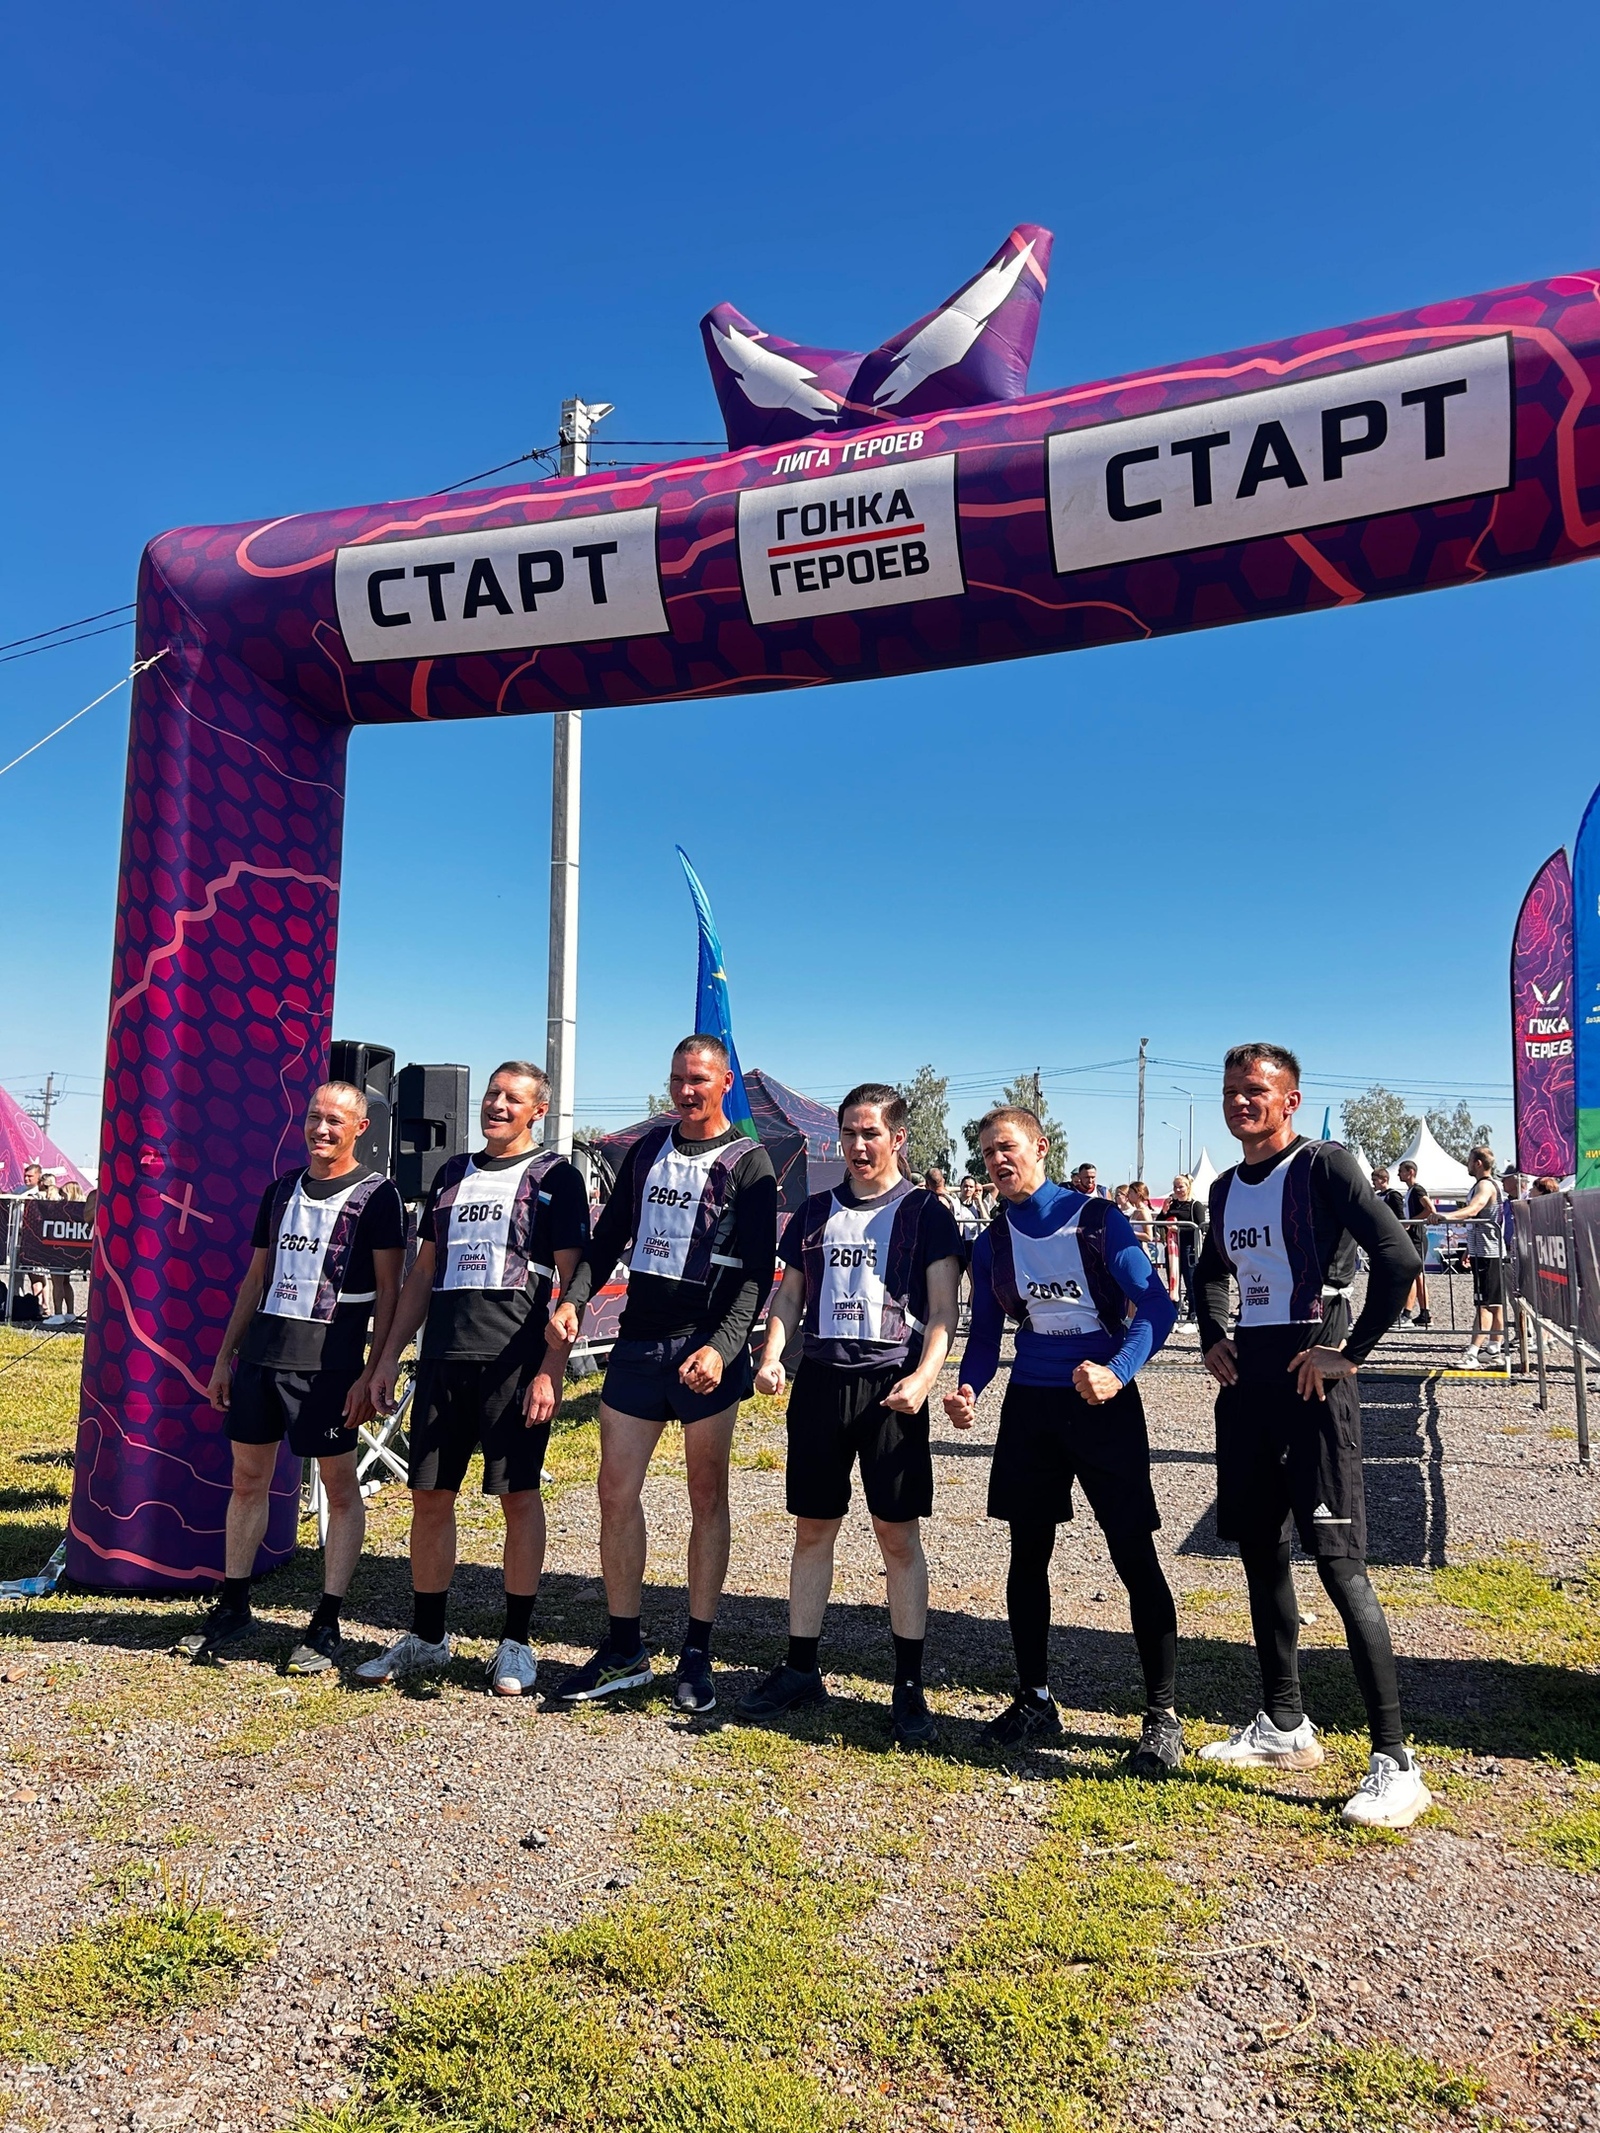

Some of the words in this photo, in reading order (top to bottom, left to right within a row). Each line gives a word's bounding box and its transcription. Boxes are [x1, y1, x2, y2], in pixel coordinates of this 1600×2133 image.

[772, 449, 830, 475] ЛИГА
[841, 430, 924, 463] ГЕРОЕВ
[1105, 378, 1467, 522] СТАРТ
[777, 488, 915, 540] ГОНКА
[769, 541, 930, 596] ГЕРОЕВ
[367, 541, 618, 628] СТАРТ
[647, 1185, 692, 1209] 260-2
[458, 1204, 503, 1223] 260-6
[280, 1233, 320, 1254] 260-4
[645, 1237, 670, 1248] ГОНКА
[1230, 1225, 1271, 1251] 260-1
[460, 1253, 486, 1261] ГОНКА
[642, 1246, 670, 1259] ГЕРОЕВ
[829, 1248, 877, 1267] 260-5
[457, 1263, 487, 1271] ГЕРОЕВ
[1027, 1280, 1081, 1300] 260-3
[1247, 1286, 1270, 1295] ГОНКА
[835, 1302, 863, 1310] ГОНКА
[1245, 1297, 1270, 1306] ГЕРОЕВ
[831, 1313, 864, 1321] ГЕРОЕВ
